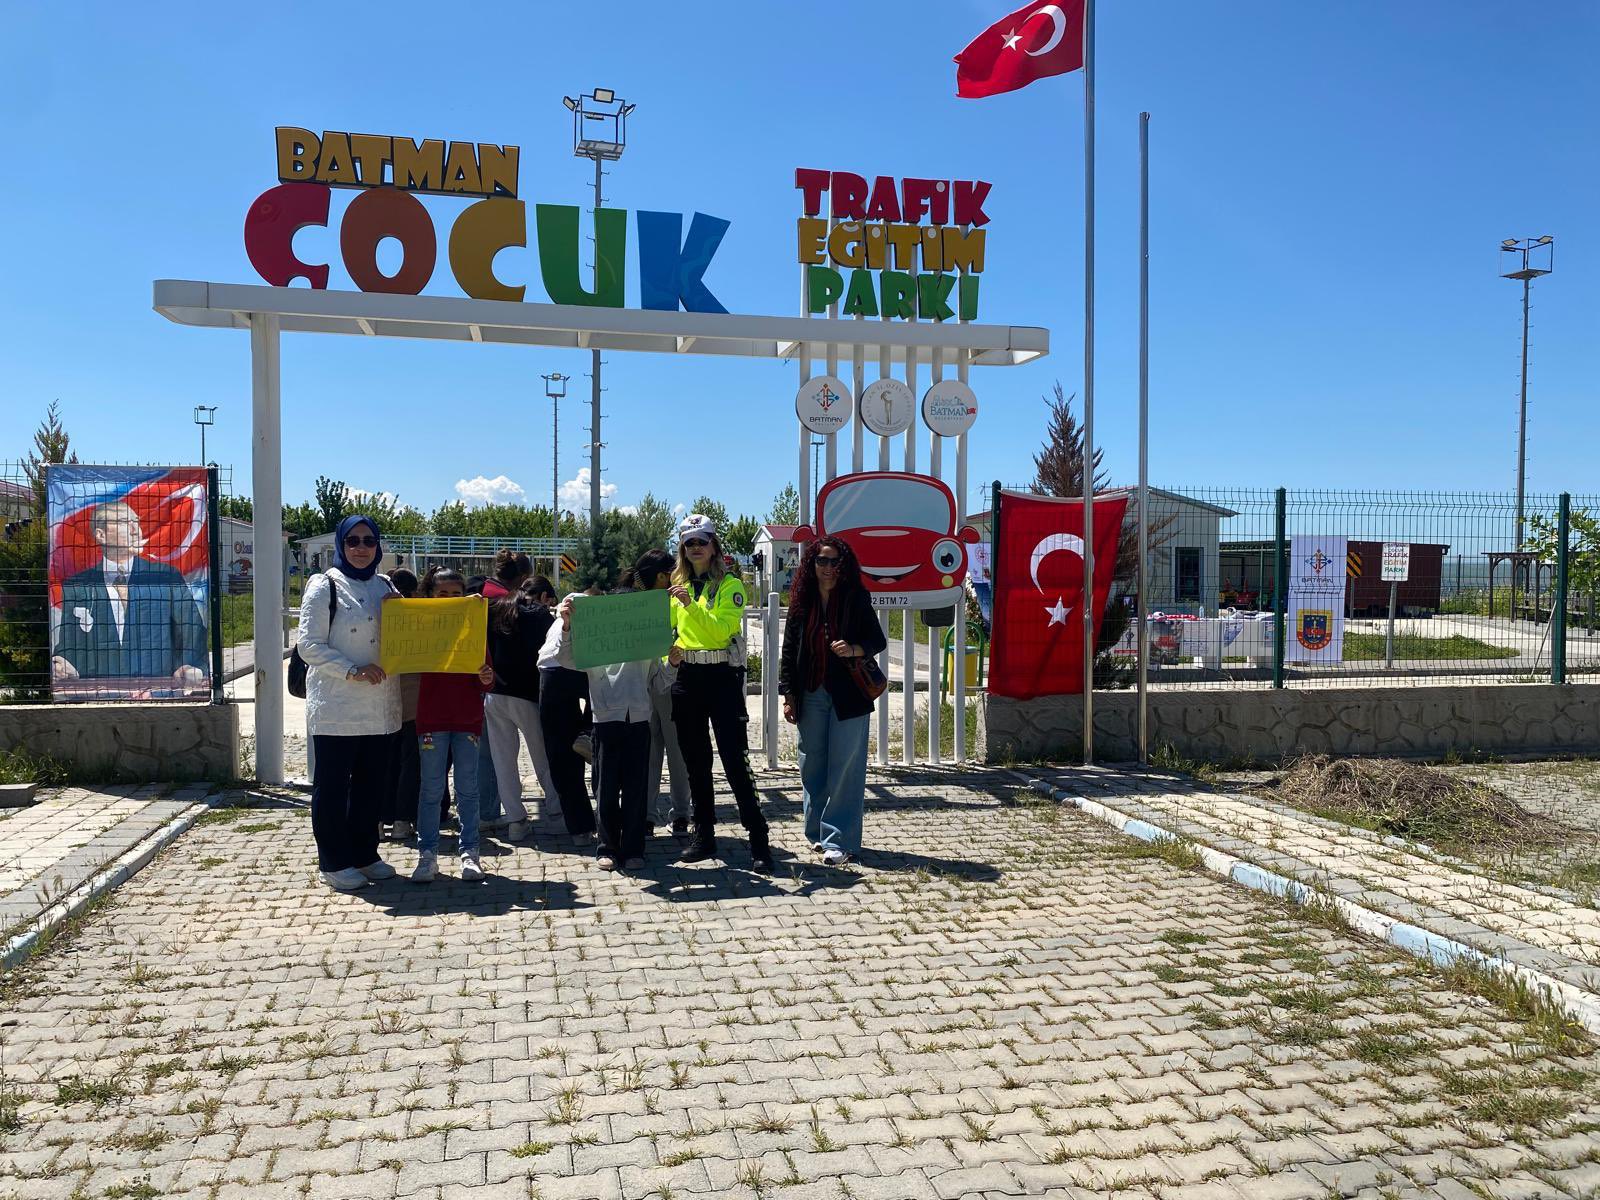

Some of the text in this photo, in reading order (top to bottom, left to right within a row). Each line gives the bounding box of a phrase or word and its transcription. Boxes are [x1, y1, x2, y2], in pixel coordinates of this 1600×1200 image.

[275, 126, 520, 200] BATMAN
[795, 168, 993, 228] TRAFİK
[244, 182, 731, 314] ÇOCUK
[797, 217, 987, 274] EĞİTİM
[808, 265, 979, 322] PARKI
[930, 405, 968, 417] BATMAN
[879, 597, 896, 605] BTM
[898, 597, 908, 605] 72
